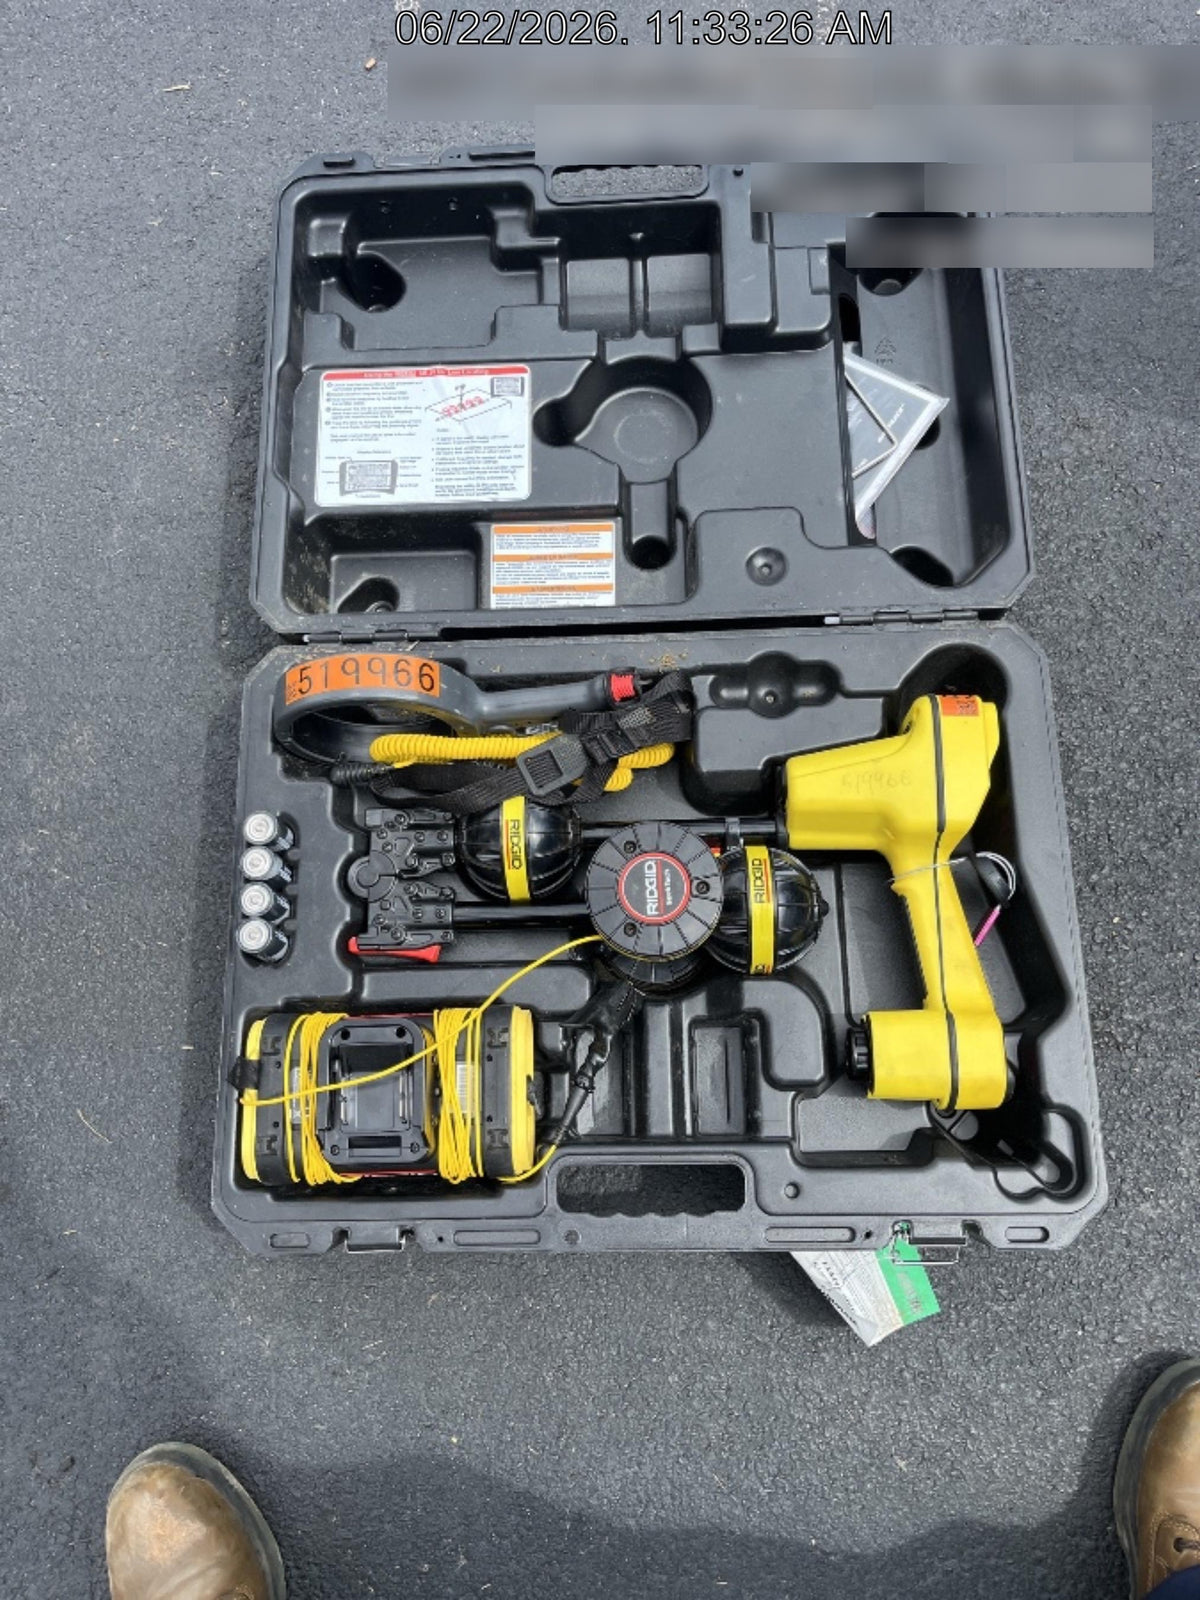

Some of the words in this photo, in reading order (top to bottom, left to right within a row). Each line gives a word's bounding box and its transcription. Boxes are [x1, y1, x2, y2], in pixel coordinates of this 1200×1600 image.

[298, 657, 435, 695] 519966
[510, 819, 523, 870] RIDGID
[644, 860, 659, 916] RIDGID
[752, 858, 766, 903] RIDGID
